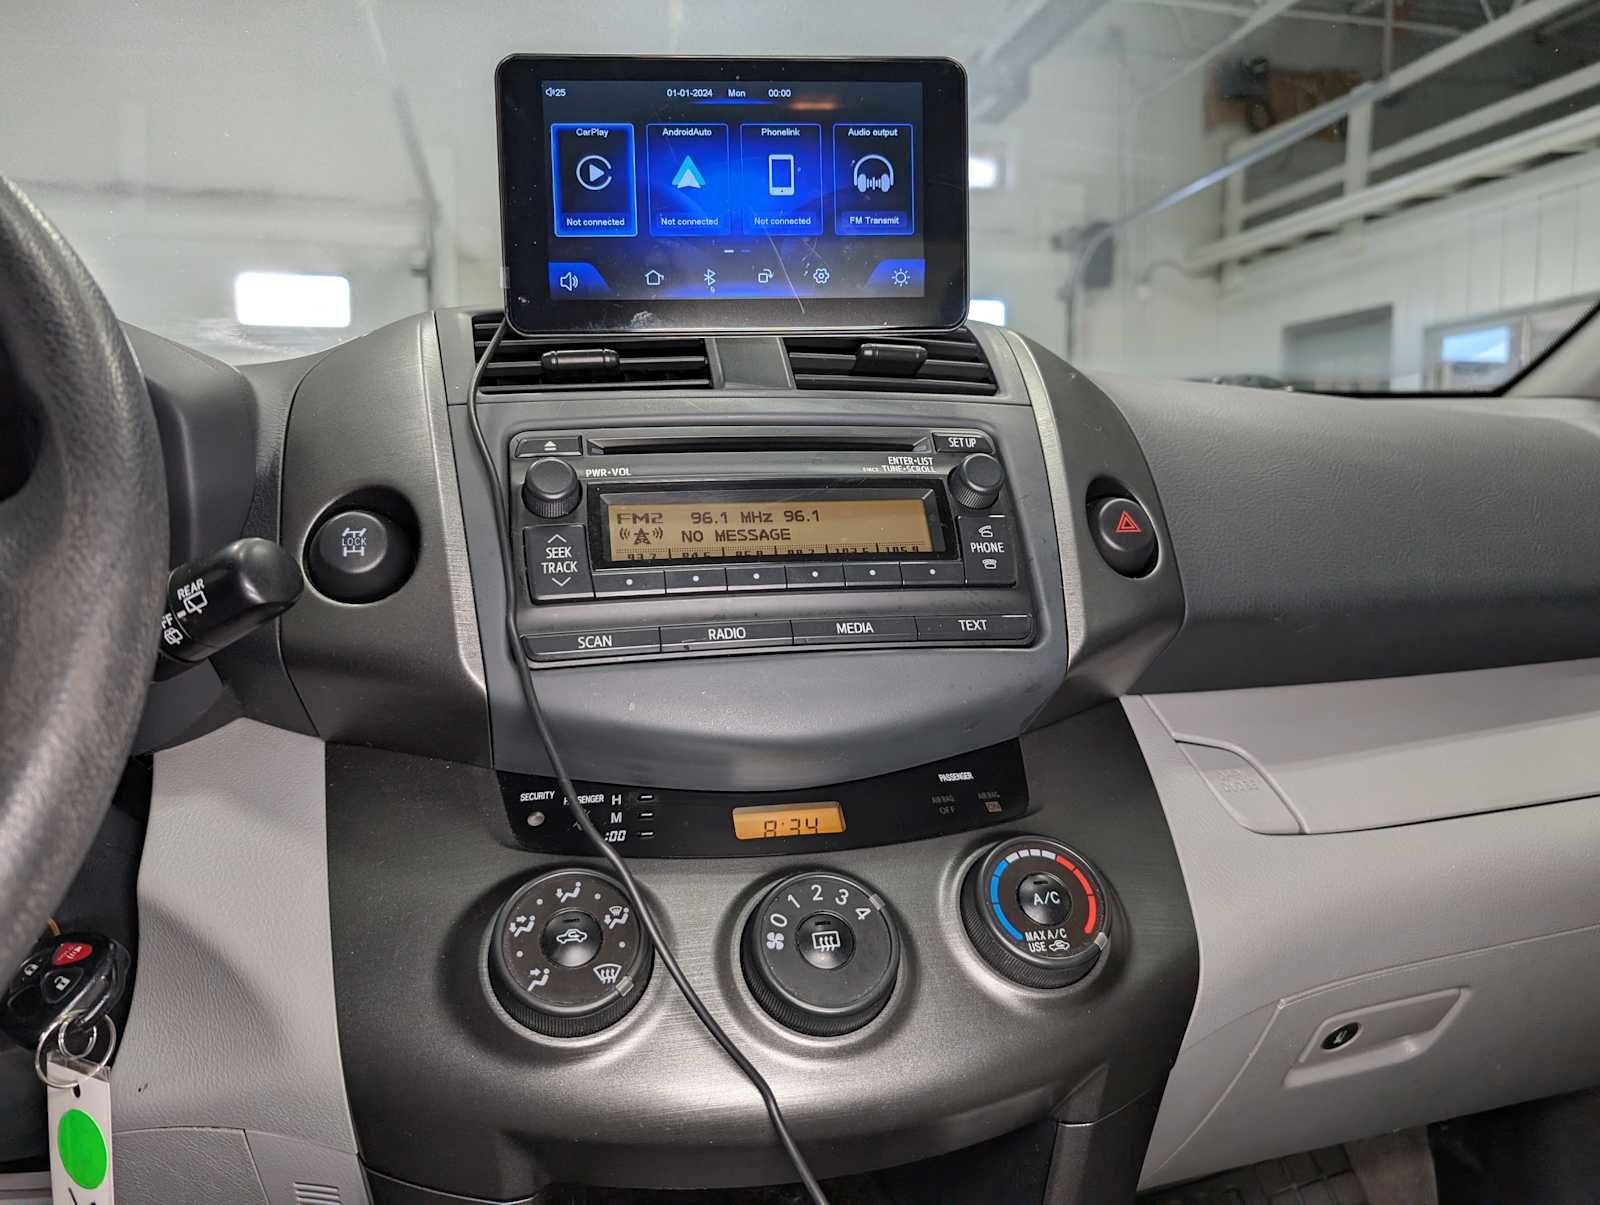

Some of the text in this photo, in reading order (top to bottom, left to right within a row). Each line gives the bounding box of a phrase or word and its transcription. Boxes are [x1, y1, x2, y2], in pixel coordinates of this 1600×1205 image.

[555, 88, 566, 97] 25
[666, 88, 792, 98] 01-01-2024 Mon 00:00
[576, 127, 609, 138] CarPlay
[662, 127, 712, 137] AndroidAuto
[761, 127, 800, 137] Phonelink
[847, 127, 898, 139] Audio output
[566, 217, 625, 227] Not connected
[661, 217, 719, 226] Not connected
[754, 216, 811, 226] Not connected
[849, 216, 900, 225] FM Transmit
[949, 437, 977, 448] SET UP
[616, 512, 664, 525] FM2
[690, 510, 821, 524] 96.1 MHz 96.1
[341, 537, 367, 546] LOCK
[682, 528, 791, 543] NO MESSAGE
[545, 546, 572, 559] SEEK
[970, 541, 1005, 554] PHONE
[541, 560, 578, 575] TRACK
[176, 578, 205, 601] REAR
[835, 621, 875, 635] MEDIA
[958, 618, 988, 632] TEXT
[707, 626, 747, 641] RADIO
[577, 634, 613, 649] SCAN
[938, 771, 974, 783] PASSENGER
[519, 790, 556, 802] SECURITY
[611, 794, 622, 806] H
[610, 812, 622, 824] M
[787, 894, 801, 909] 1
[810, 884, 824, 901] 2
[835, 888, 849, 905] 3
[855, 907, 872, 920] 4
[1033, 890, 1061, 906] A/C
[1025, 927, 1067, 942] MAX A/C
[1028, 941, 1047, 953] USE
